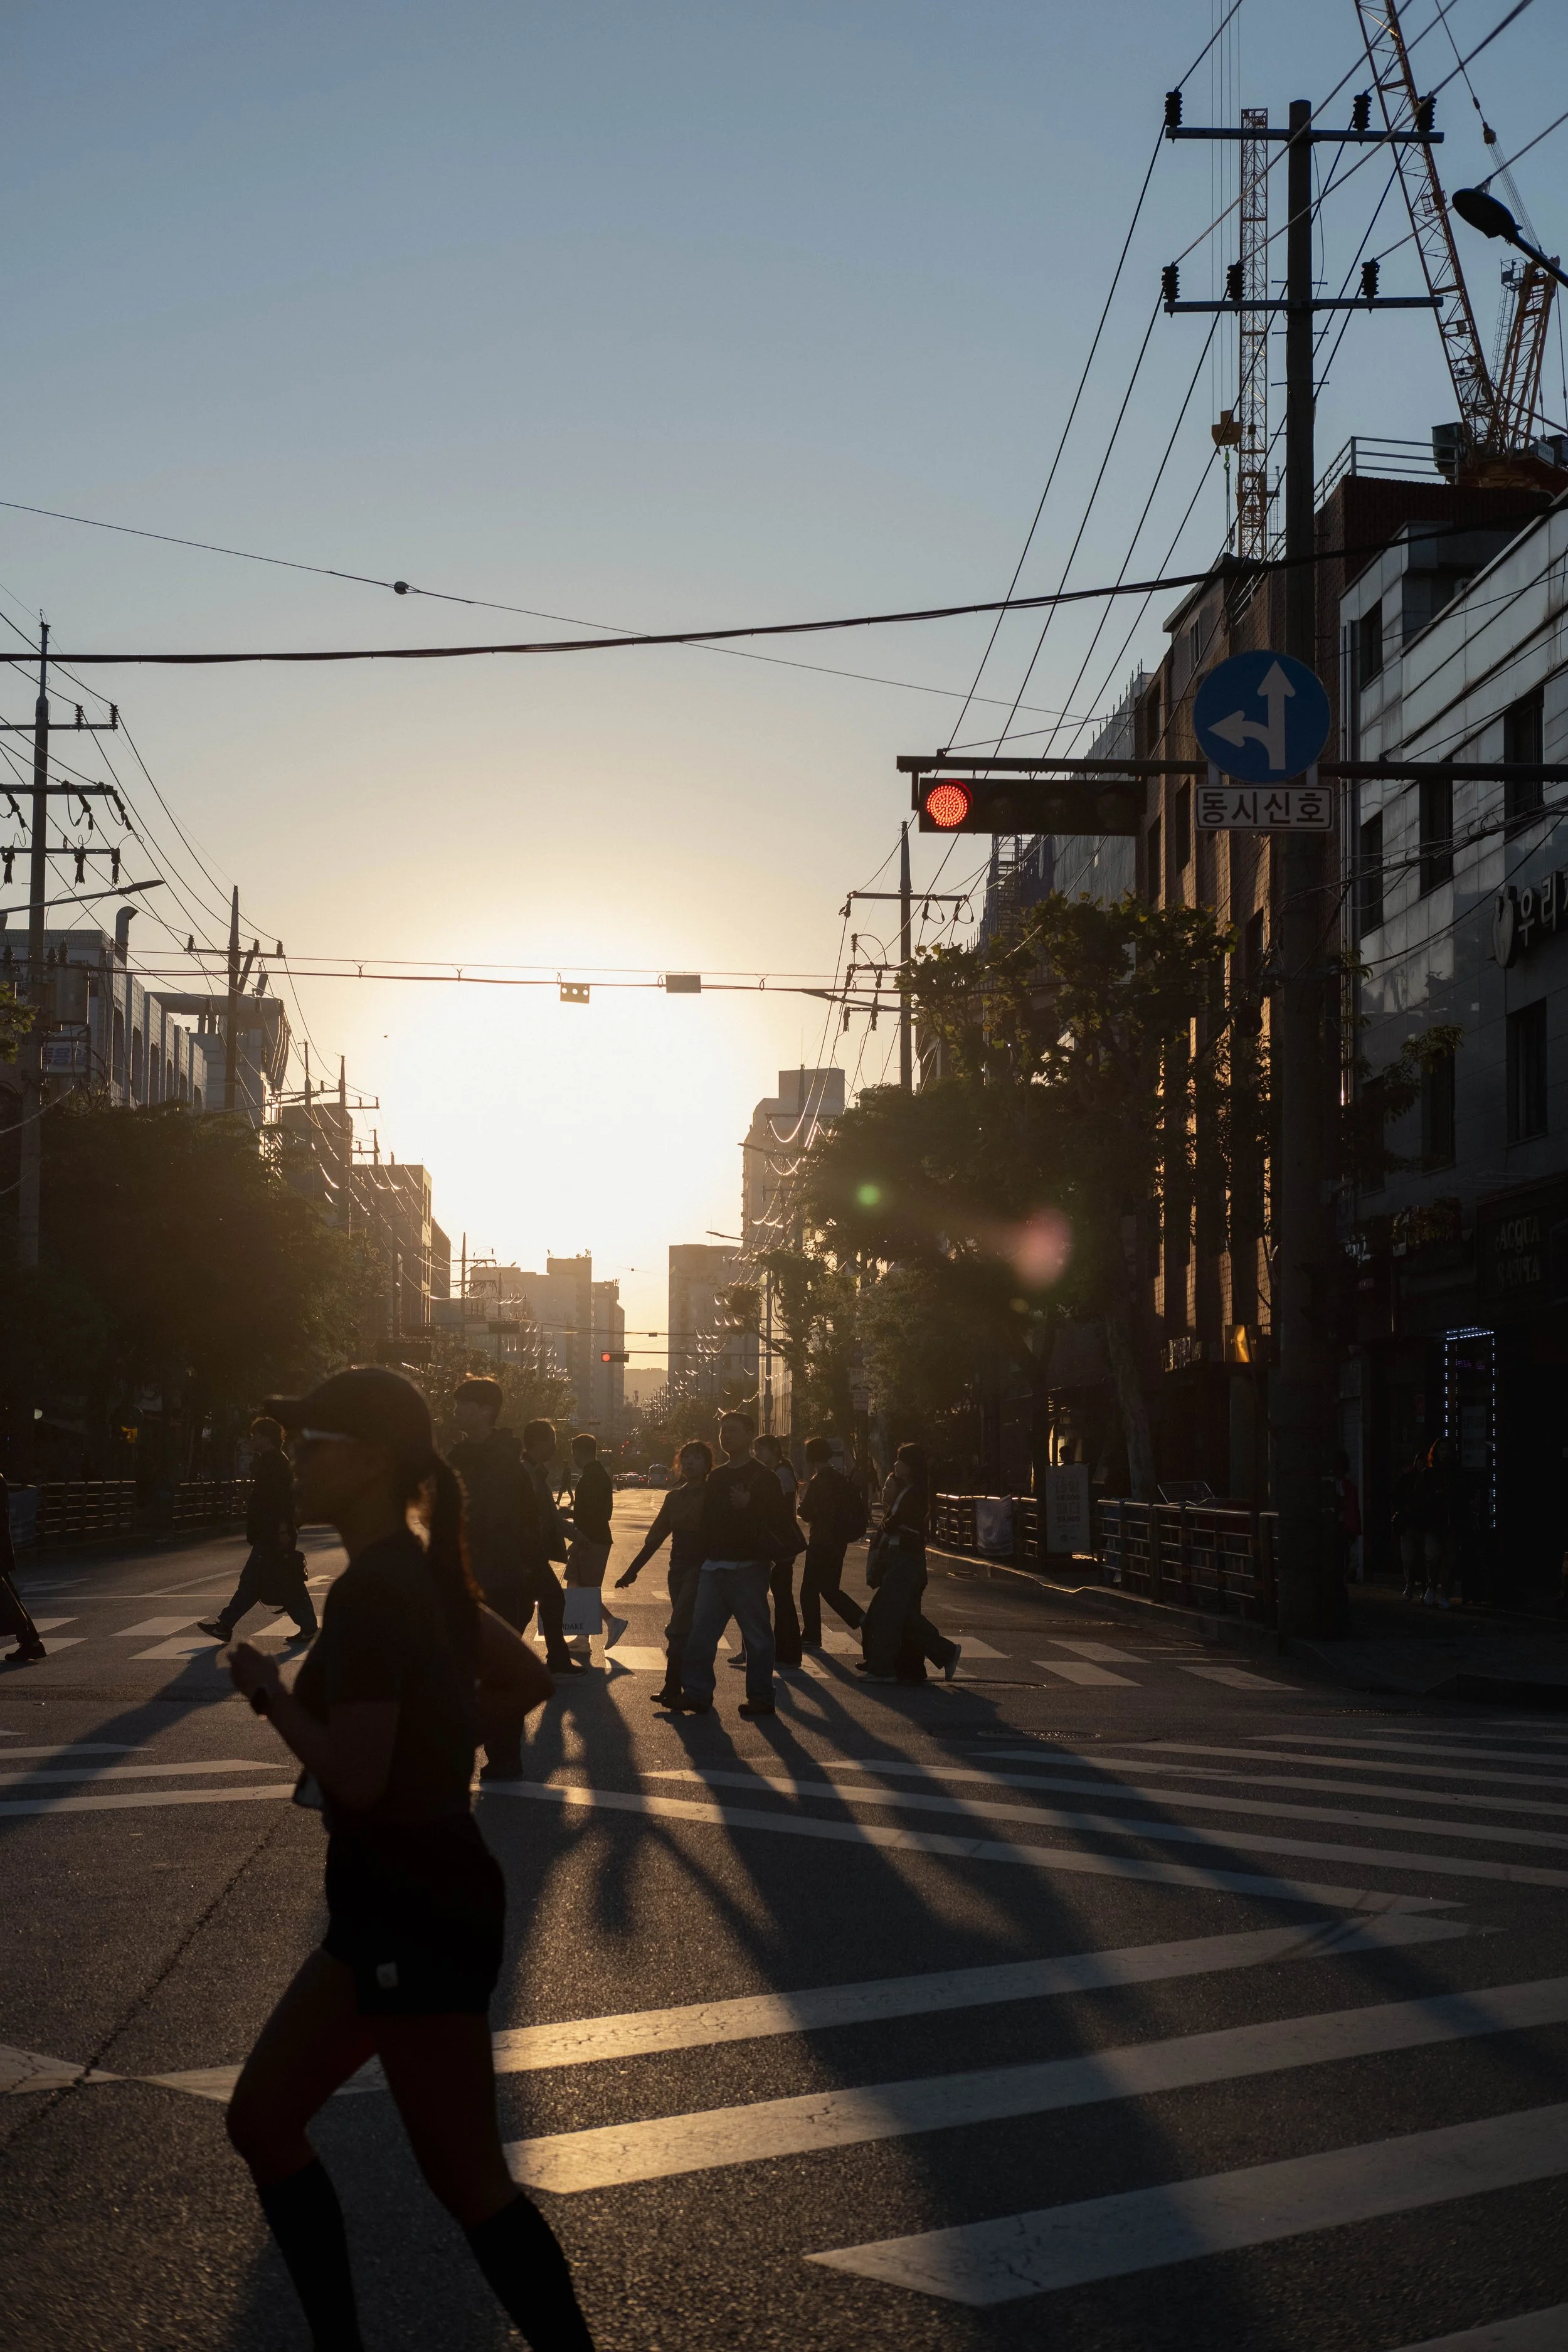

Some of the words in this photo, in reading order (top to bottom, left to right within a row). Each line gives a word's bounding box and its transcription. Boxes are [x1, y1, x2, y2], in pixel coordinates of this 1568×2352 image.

[1202, 792, 1325, 824] 동시신호
[1495, 1215, 1541, 1254] ACQUA
[1496, 1254, 1541, 1291] SANTA
[563, 1623, 584, 1631] DAKE
